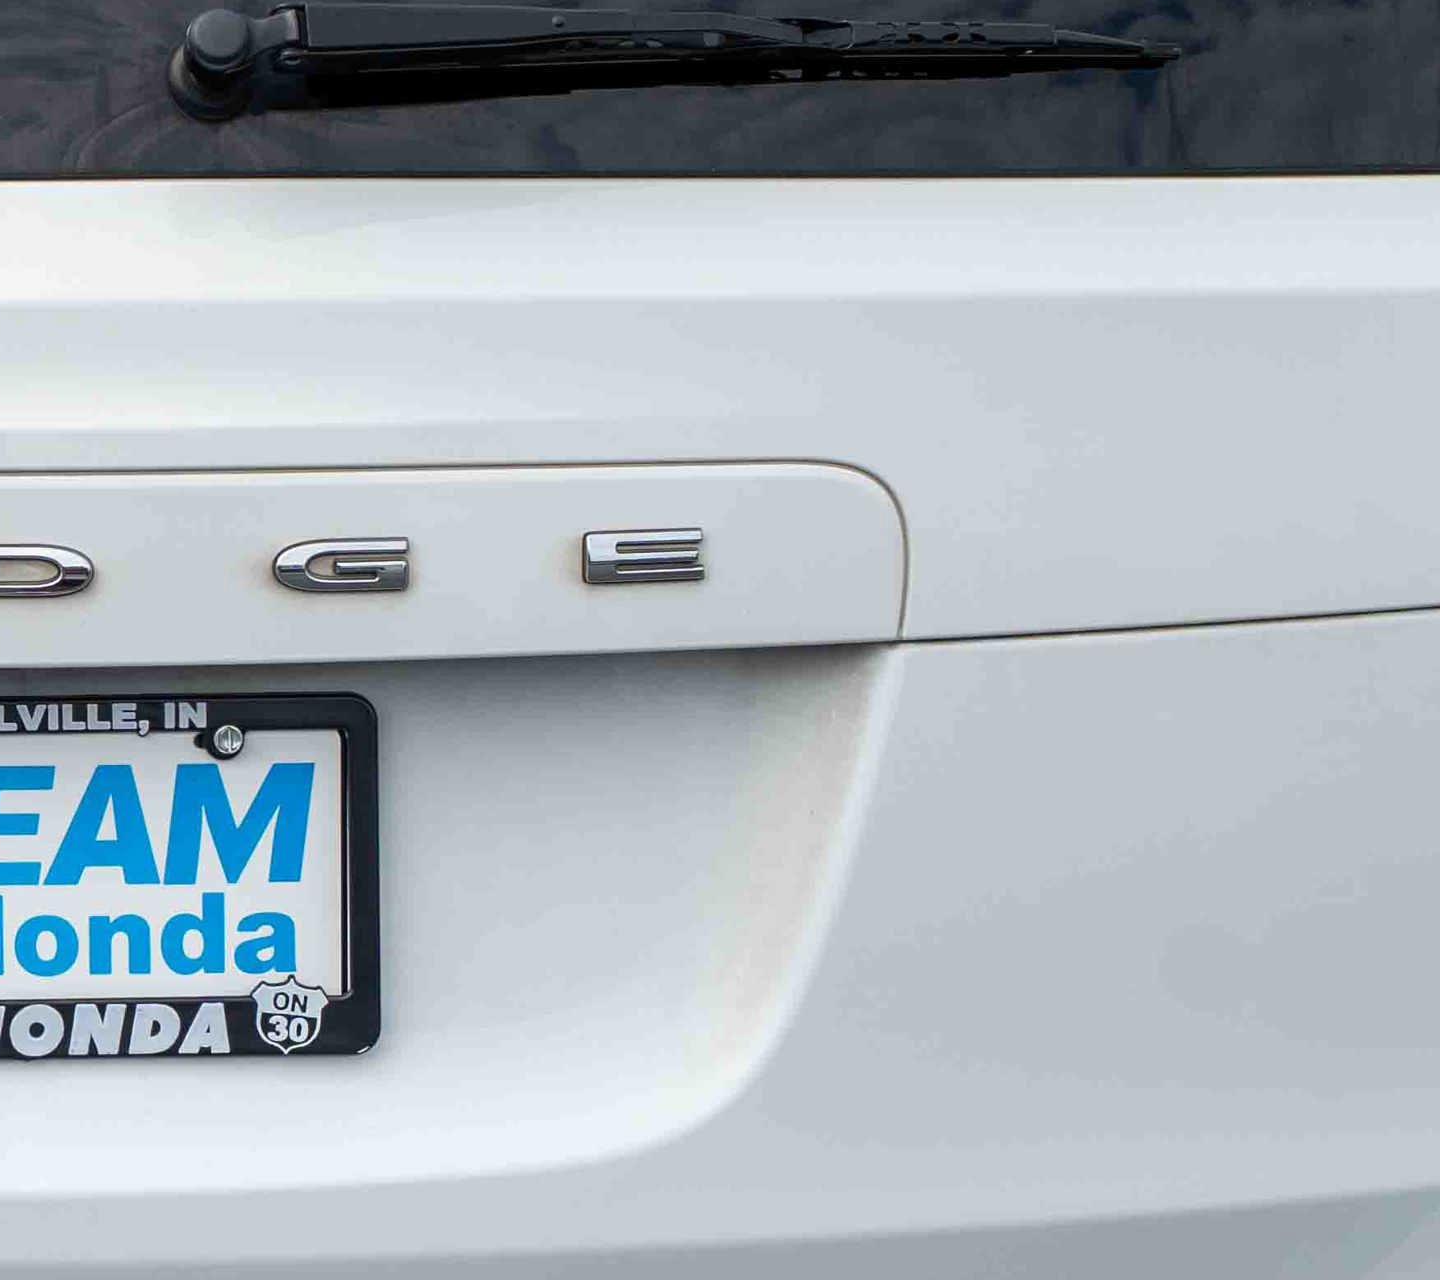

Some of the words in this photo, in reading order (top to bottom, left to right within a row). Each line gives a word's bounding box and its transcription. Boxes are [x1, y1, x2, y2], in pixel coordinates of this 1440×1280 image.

[163, 701, 208, 729] IN
[272, 991, 309, 1014] ON
[266, 1014, 310, 1043] 30
